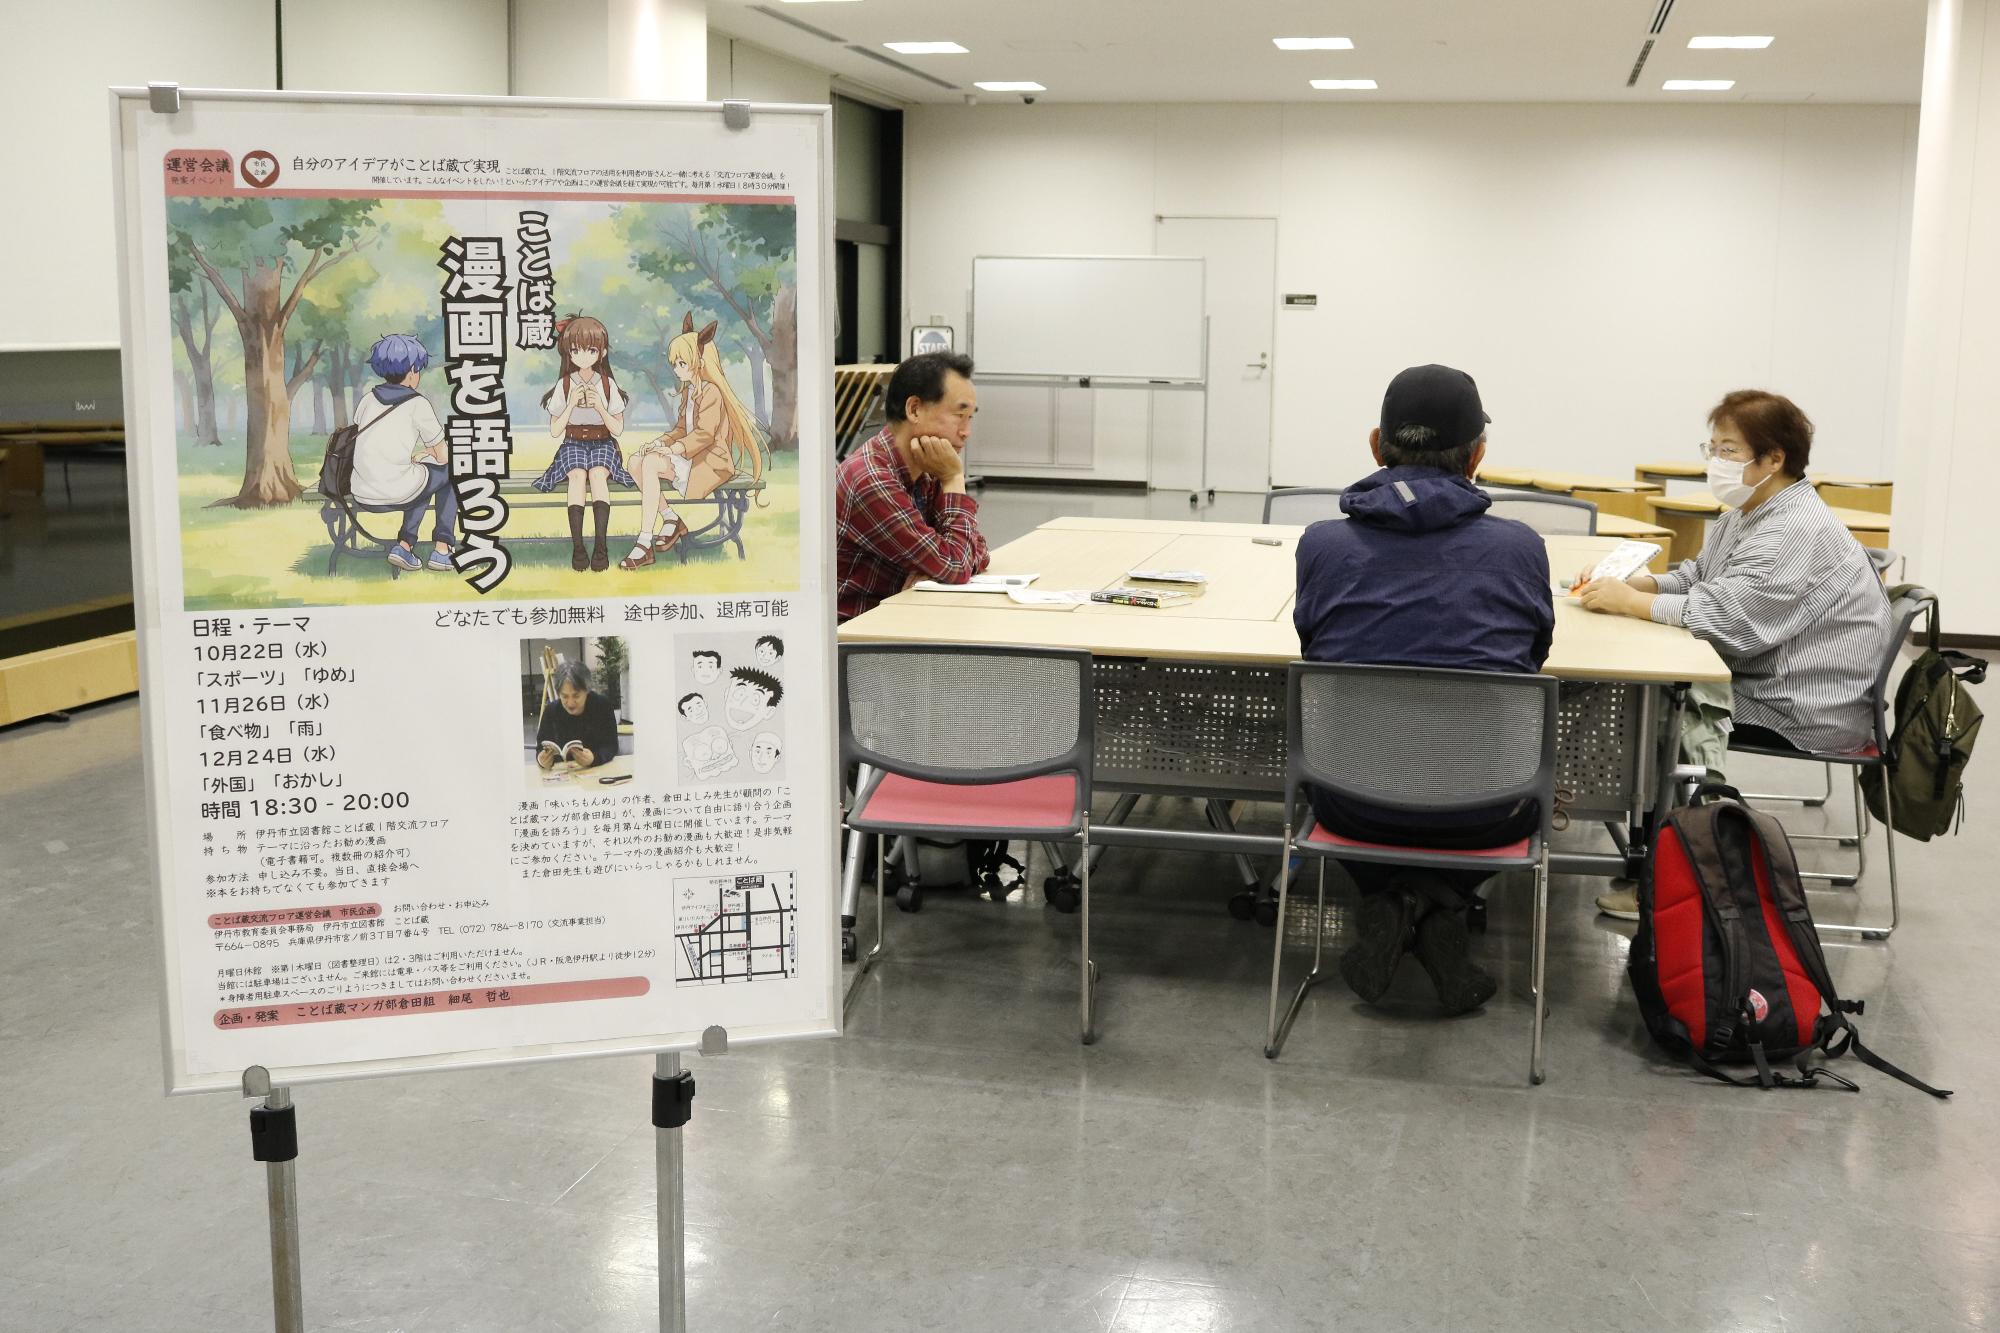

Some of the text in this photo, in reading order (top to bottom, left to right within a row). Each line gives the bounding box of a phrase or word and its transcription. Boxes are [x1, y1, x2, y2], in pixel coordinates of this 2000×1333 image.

[166, 157, 231, 174] 運営会議
[292, 155, 501, 174] 自分のアイデアがことば蔵で実現
[516, 210, 557, 351] ことば蔵
[438, 236, 512, 594] 漫画を語ろう
[434, 599, 790, 628] どなたでも参加無料 途中参加、退席可能
[193, 616, 310, 637] 日程・テーマ
[194, 641, 327, 662] 10月22日（水）
[197, 693, 330, 714] 11月26日（水）
[199, 745, 336, 767] 12月24日（水）
[201, 801, 241, 820] 時間
[249, 796, 318, 817] 18:30
[342, 791, 410, 811] 20:00
[256, 836, 387, 852] テーマに沿ったお勧め漫画
[205, 862, 420, 884] 参加方法 申し込み不要。当日、直接会場へ
[214, 906, 376, 926] ことば蔵交流フロア運営会議 市民企画
[323, 918, 385, 932] 伊丹市立図書館
[395, 915, 430, 926] ことば蔵
[217, 967, 262, 978] 月曜日休館
[219, 989, 511, 1026] 企画・発案 ことば蔵マンガ部倉田組 細尾 哲也
